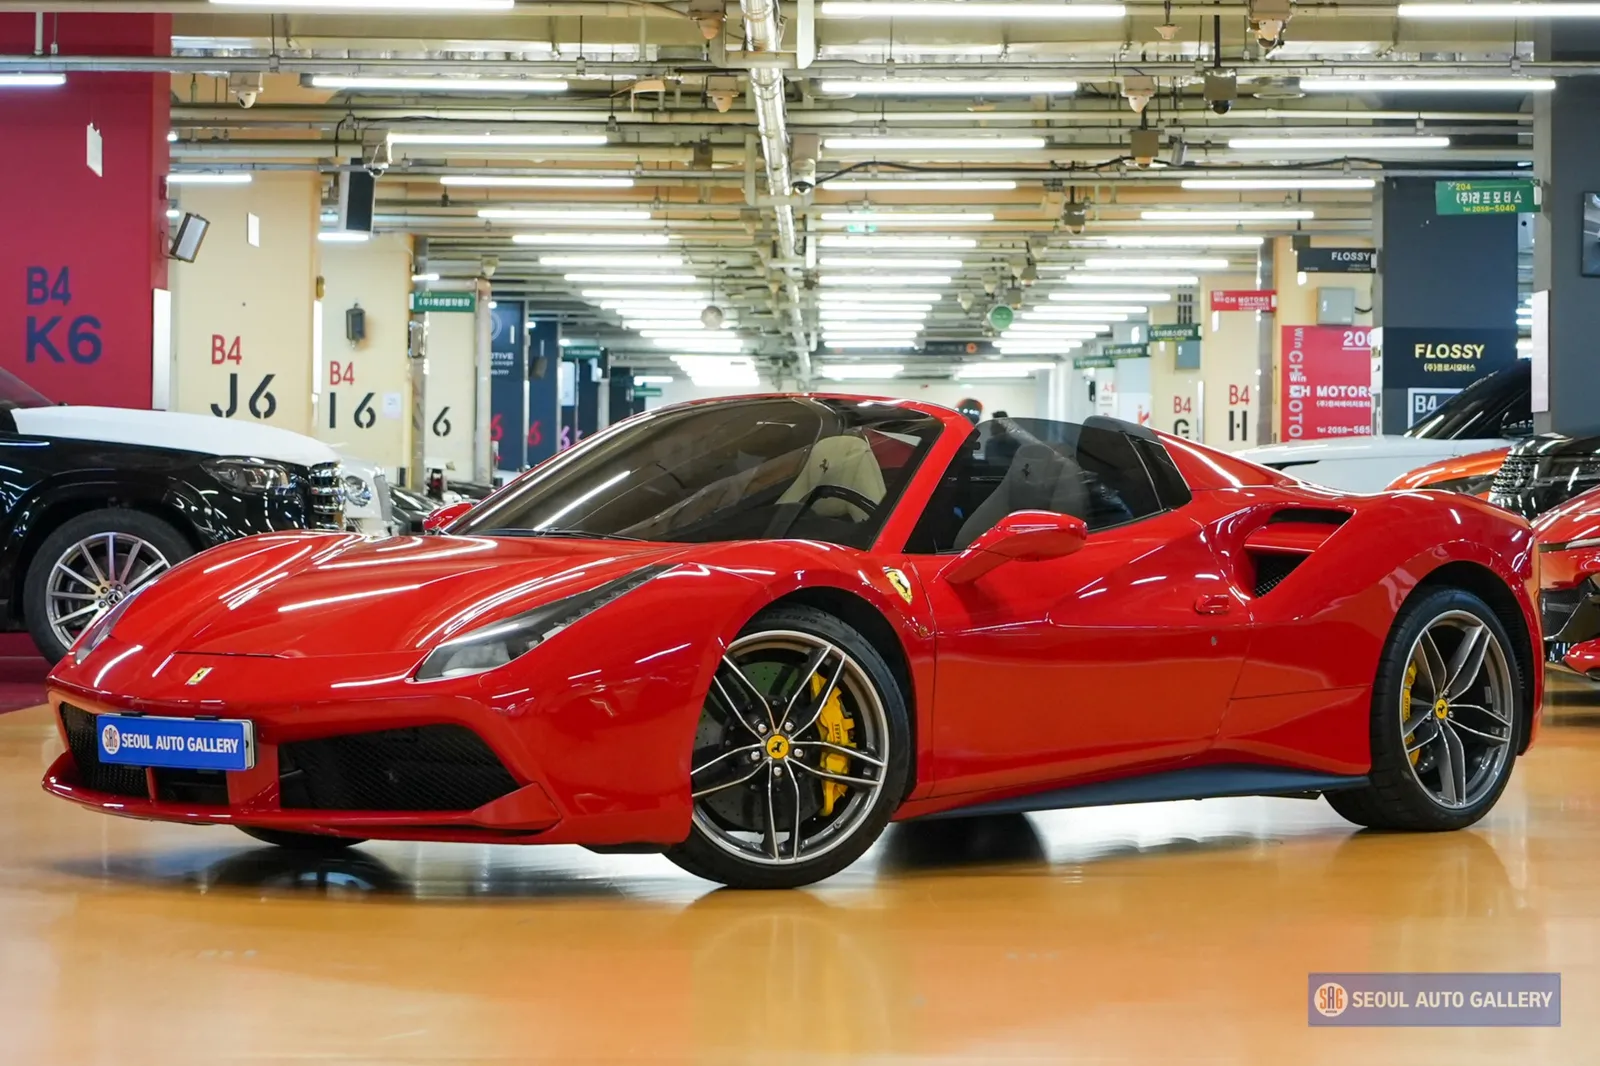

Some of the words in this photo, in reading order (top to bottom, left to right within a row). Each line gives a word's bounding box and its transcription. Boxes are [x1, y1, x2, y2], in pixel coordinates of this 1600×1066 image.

[1456, 183, 1471, 191] 204
[1331, 252, 1370, 261] FLOSSY
[26, 266, 72, 306] B4
[26, 315, 102, 364] K6
[211, 334, 243, 365] B4
[1415, 343, 1485, 359] FLOSSY
[329, 360, 355, 385] B4
[1174, 396, 1192, 414] B4
[1229, 384, 1250, 405] B4
[1415, 395, 1438, 413] B4
[432, 406, 451, 437] 6
[1229, 410, 1247, 441] H
[122, 732, 153, 750] SEOUL
[155, 735, 185, 752] AUTO
[187, 737, 240, 754] GALLERY
